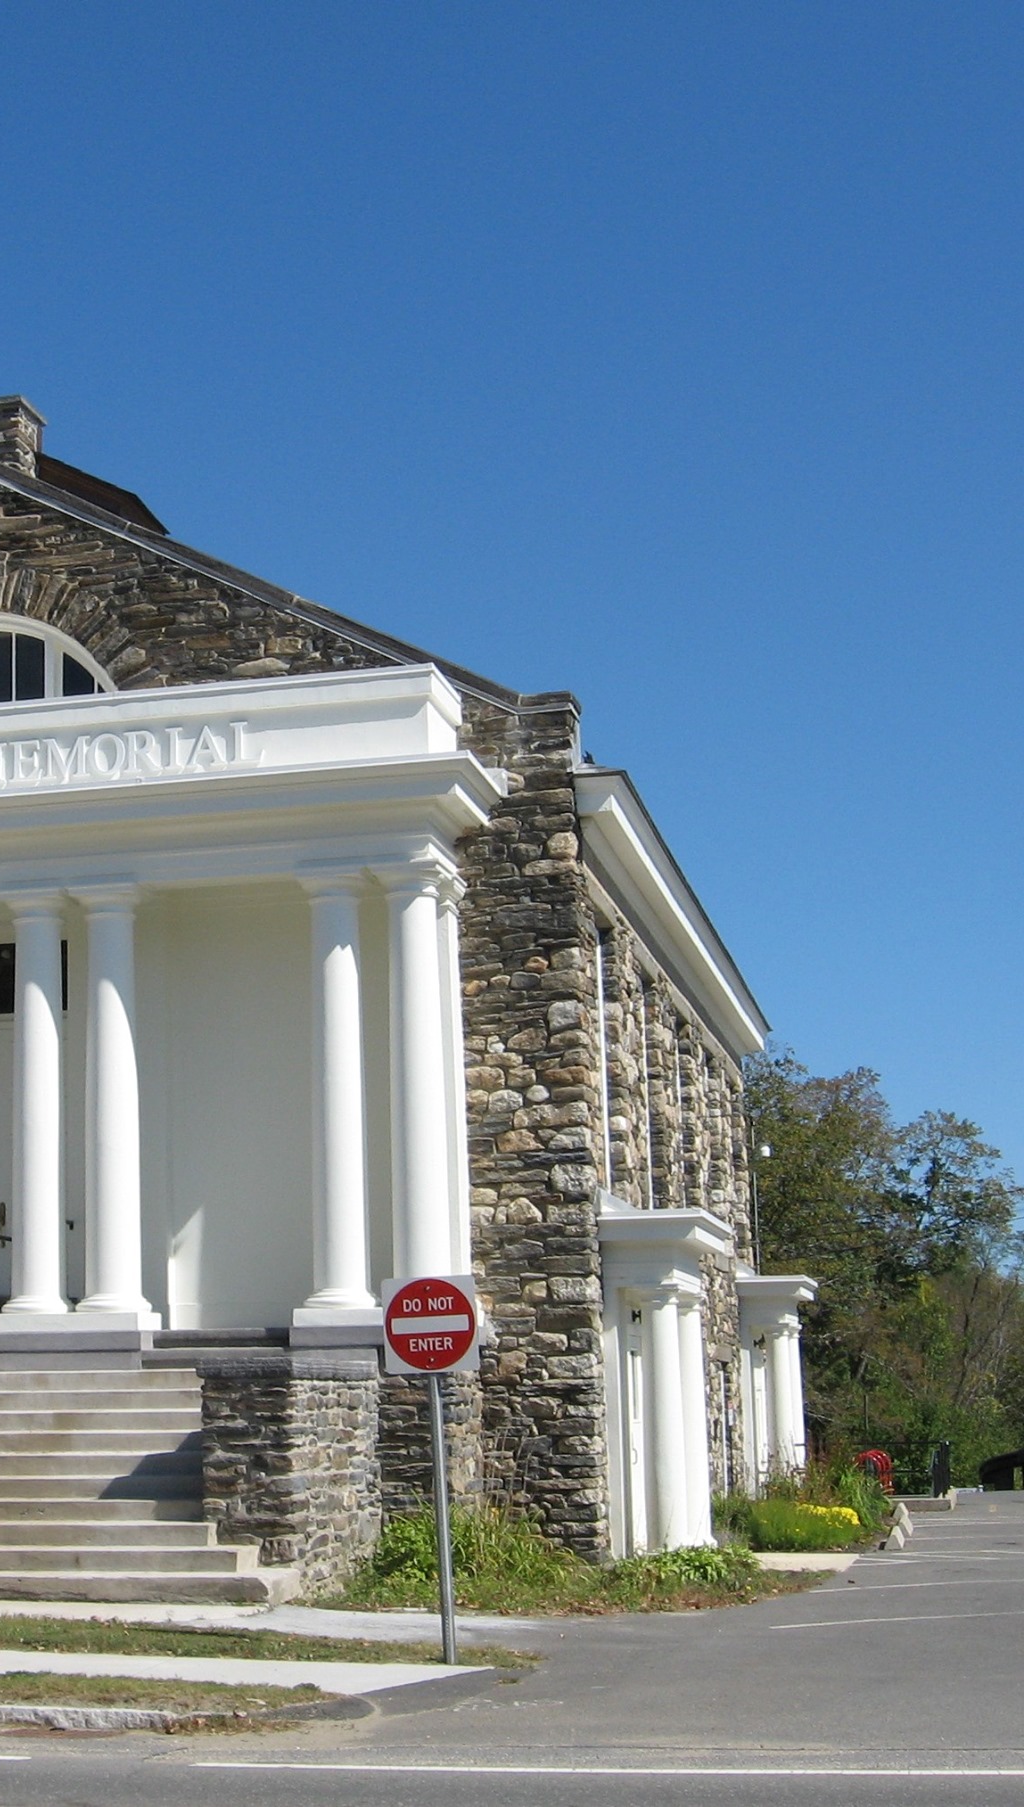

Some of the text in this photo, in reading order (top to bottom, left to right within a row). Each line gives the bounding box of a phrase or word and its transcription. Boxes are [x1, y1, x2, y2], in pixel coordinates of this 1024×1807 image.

[402, 1296, 454, 1313] DO NOT
[409, 1336, 454, 1352] ENTER
